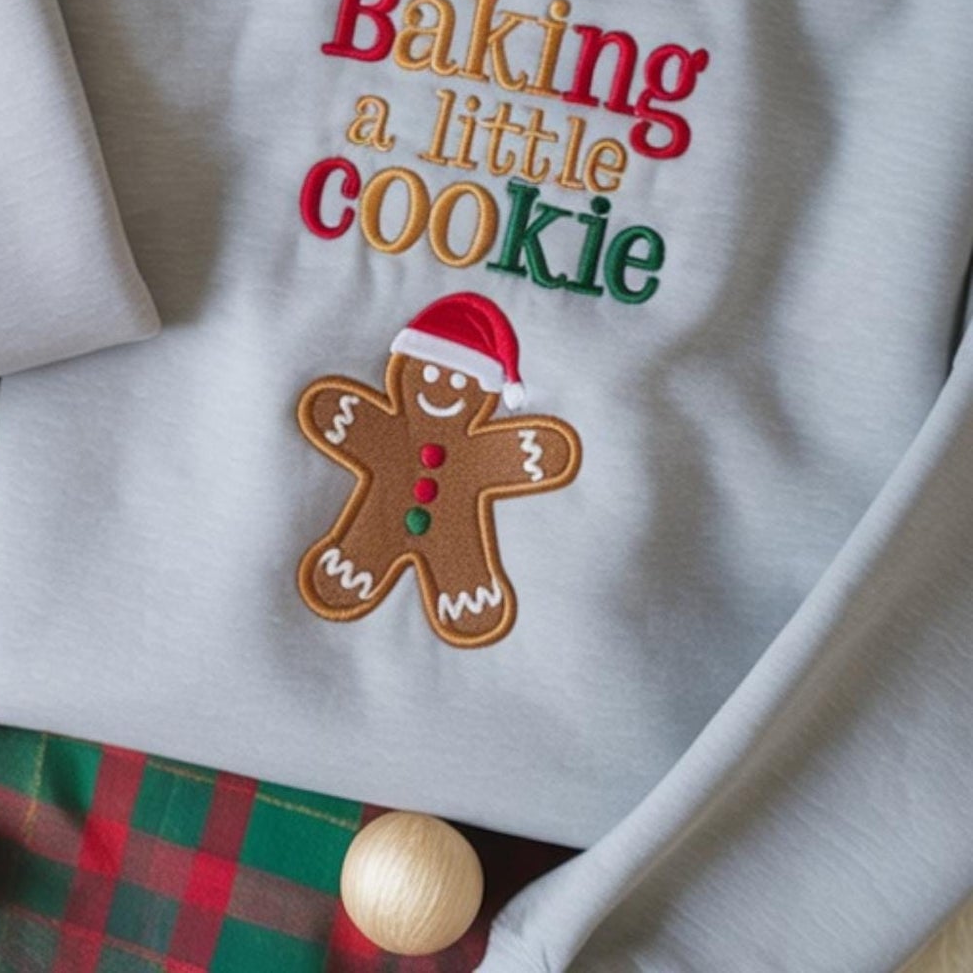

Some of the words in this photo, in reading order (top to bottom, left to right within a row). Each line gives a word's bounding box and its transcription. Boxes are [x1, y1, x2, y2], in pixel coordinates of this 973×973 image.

[346, 95, 395, 152] a
[419, 89, 629, 194] little
[298, 156, 665, 305] cookie
